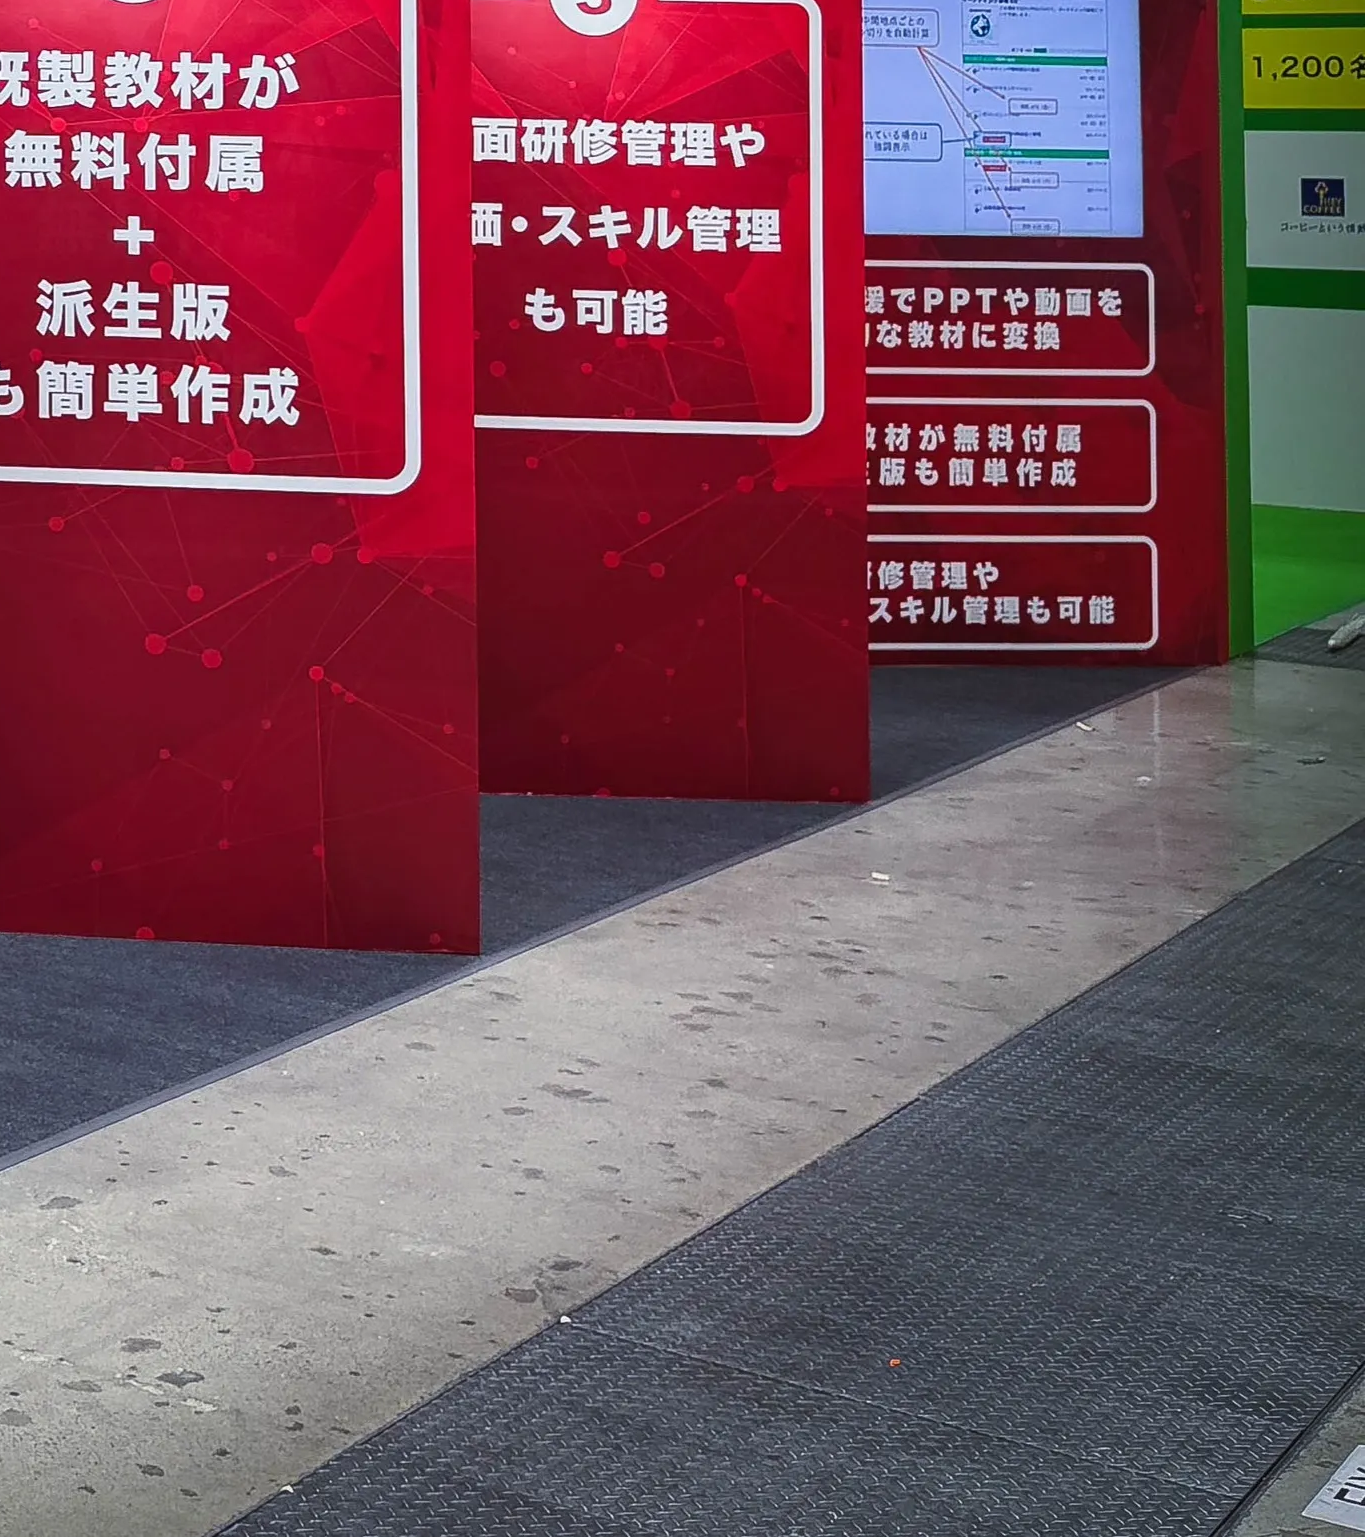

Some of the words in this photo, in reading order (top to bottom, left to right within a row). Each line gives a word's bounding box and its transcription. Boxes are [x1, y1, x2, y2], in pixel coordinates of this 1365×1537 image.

[4, 130, 265, 194] 無料付属
[35, 279, 231, 341] 派生版
[524, 288, 668, 337] も可能
[864, 320, 1060, 351] な教材に変換
[866, 457, 1077, 487] 版も簡単作成
[866, 560, 1000, 591] 修管理や
